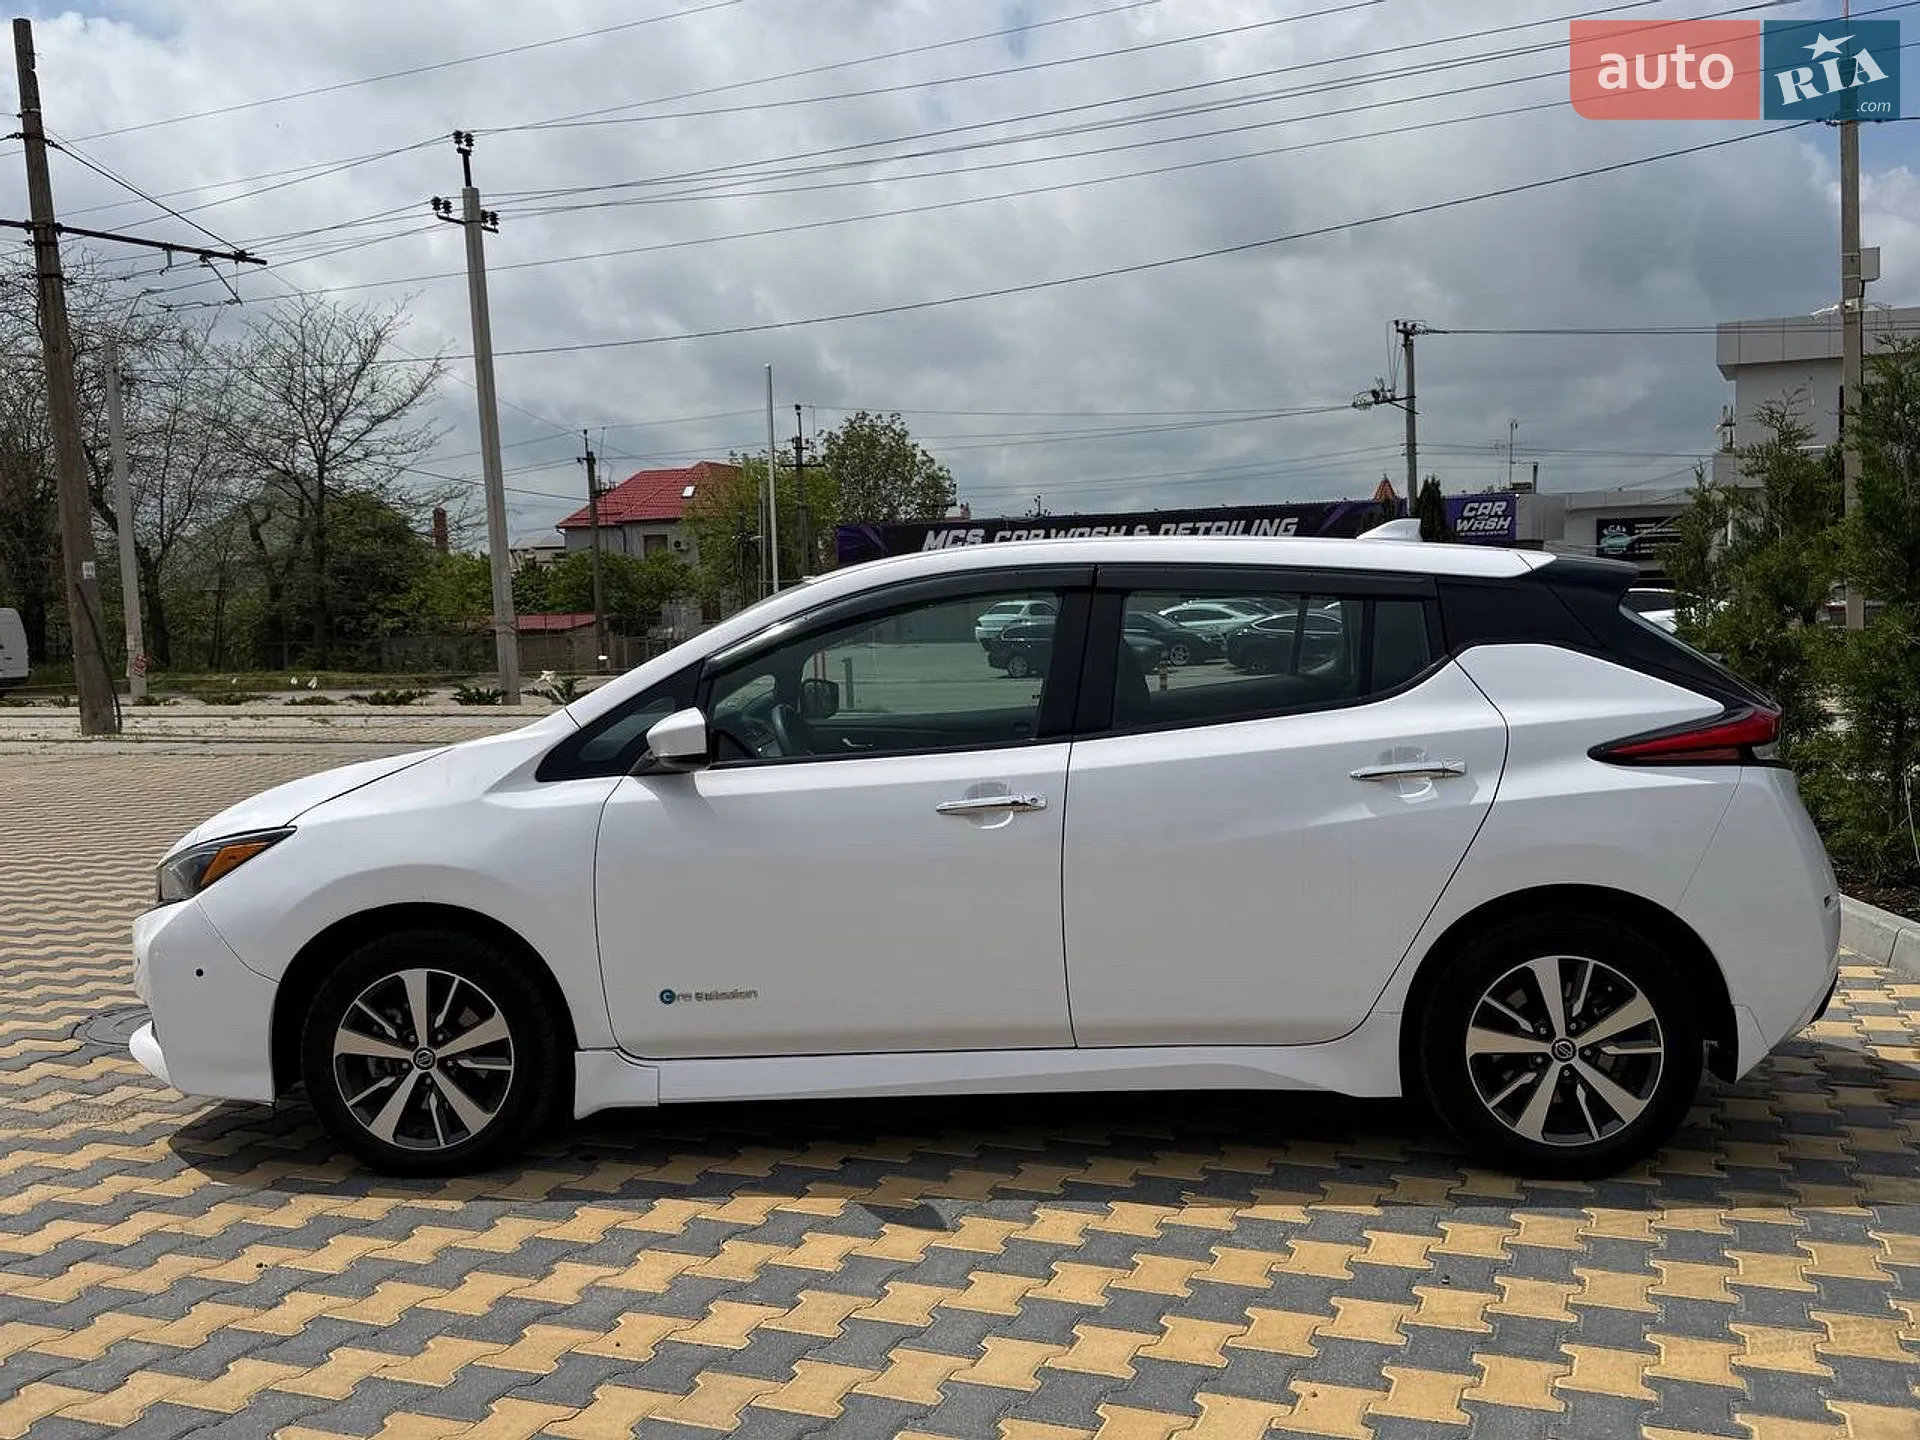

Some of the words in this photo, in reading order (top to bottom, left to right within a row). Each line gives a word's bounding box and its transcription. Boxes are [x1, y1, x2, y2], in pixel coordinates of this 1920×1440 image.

[1462, 501, 1507, 517] CAR
[1456, 516, 1512, 532] WASH
[922, 528, 985, 551] MCS
[1158, 517, 1298, 537] DETAILING
